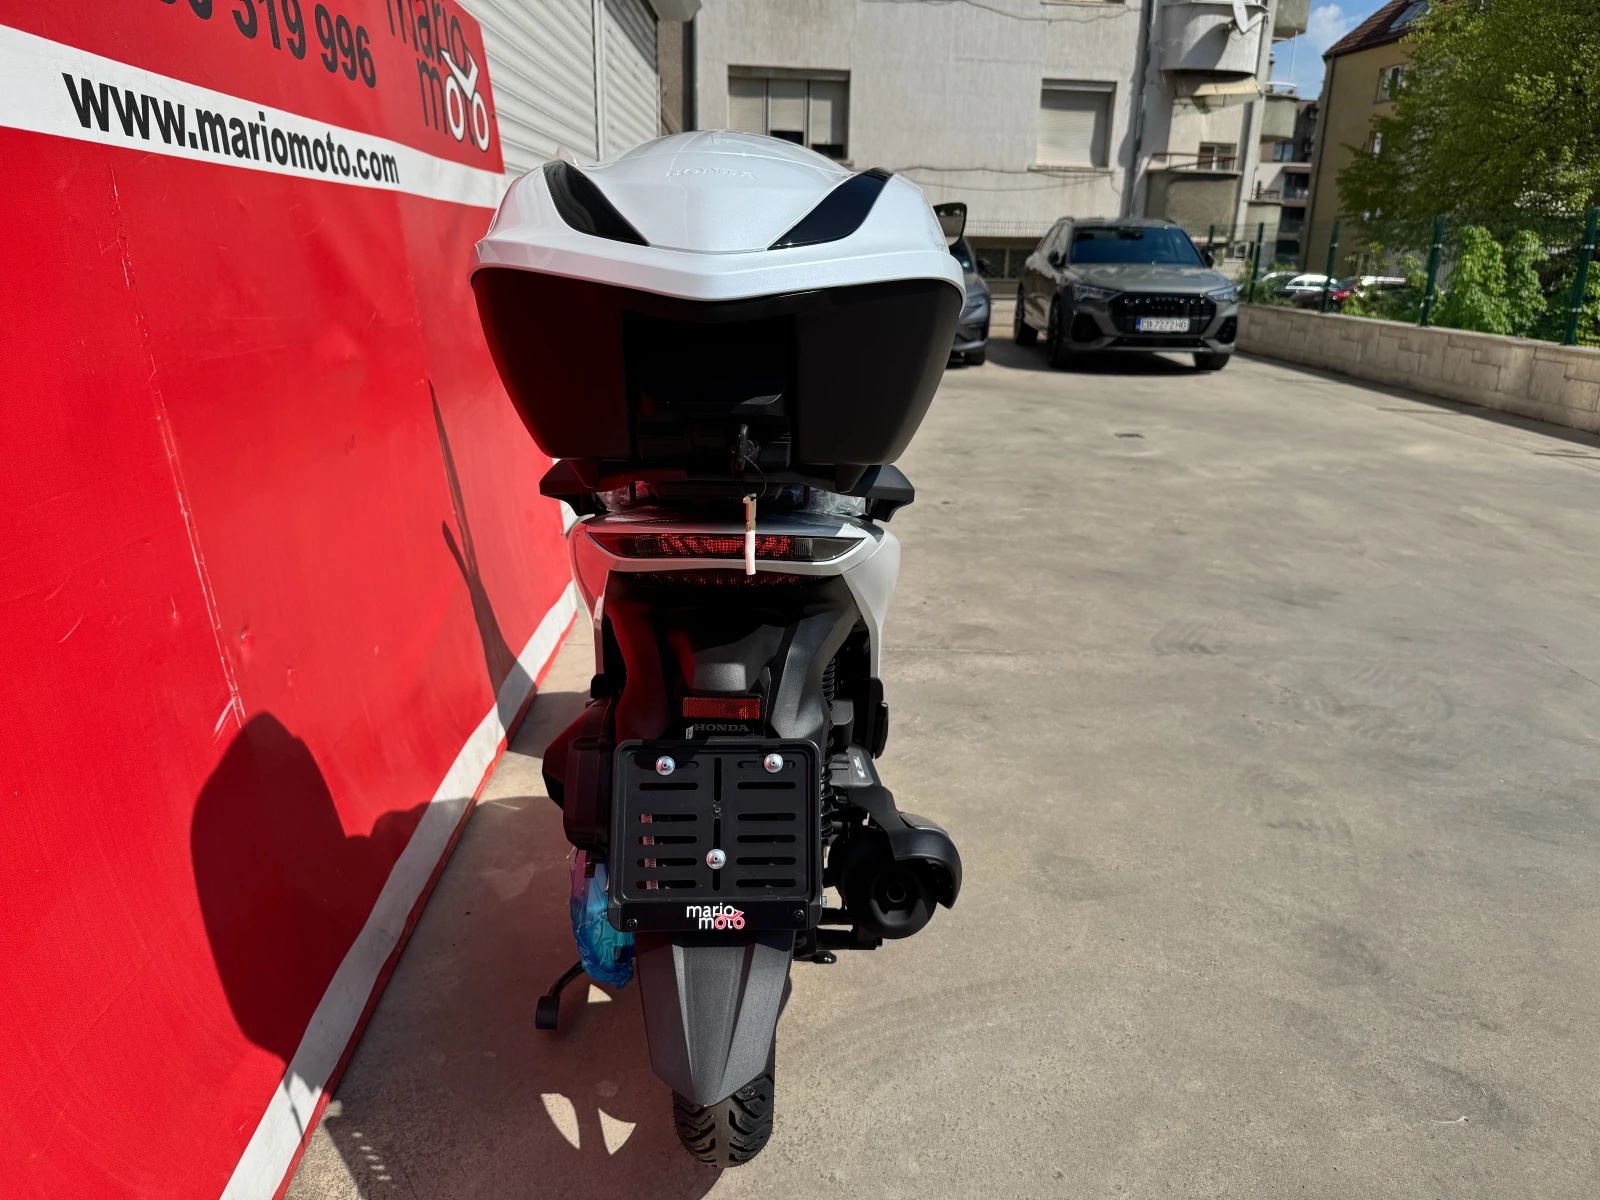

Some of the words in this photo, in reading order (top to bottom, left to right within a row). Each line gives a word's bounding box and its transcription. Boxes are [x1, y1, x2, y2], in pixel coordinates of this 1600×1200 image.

[315, 4, 376, 88] 996
[416, 58, 490, 153] moto
[62, 73, 399, 184] www.mariomoto.com
[665, 167, 758, 180] HONDA
[693, 723, 750, 732] HONDA
[686, 902, 735, 918] mario
[698, 916, 746, 930] moto
